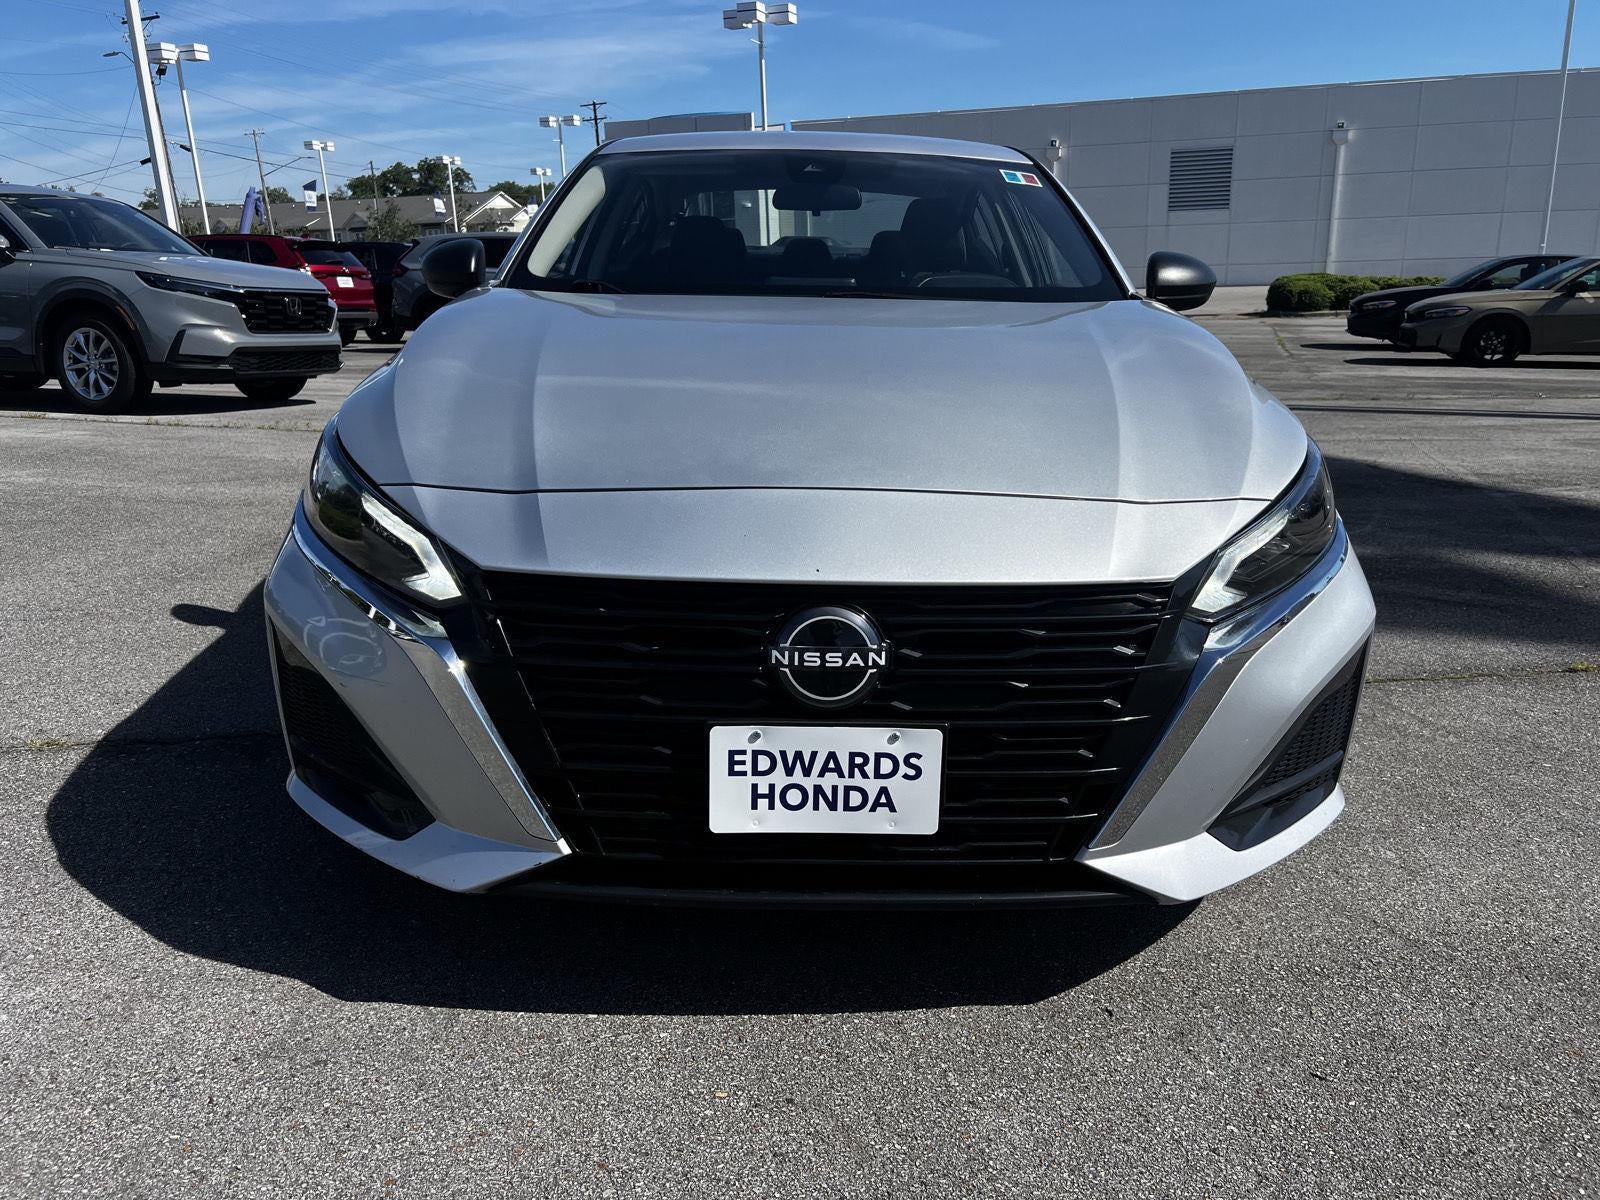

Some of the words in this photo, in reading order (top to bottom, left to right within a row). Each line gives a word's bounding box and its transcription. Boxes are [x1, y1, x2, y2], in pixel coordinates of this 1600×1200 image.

[771, 650, 886, 667] NISSAN
[727, 749, 923, 781] EDWARDS
[750, 783, 898, 813] HONDA
